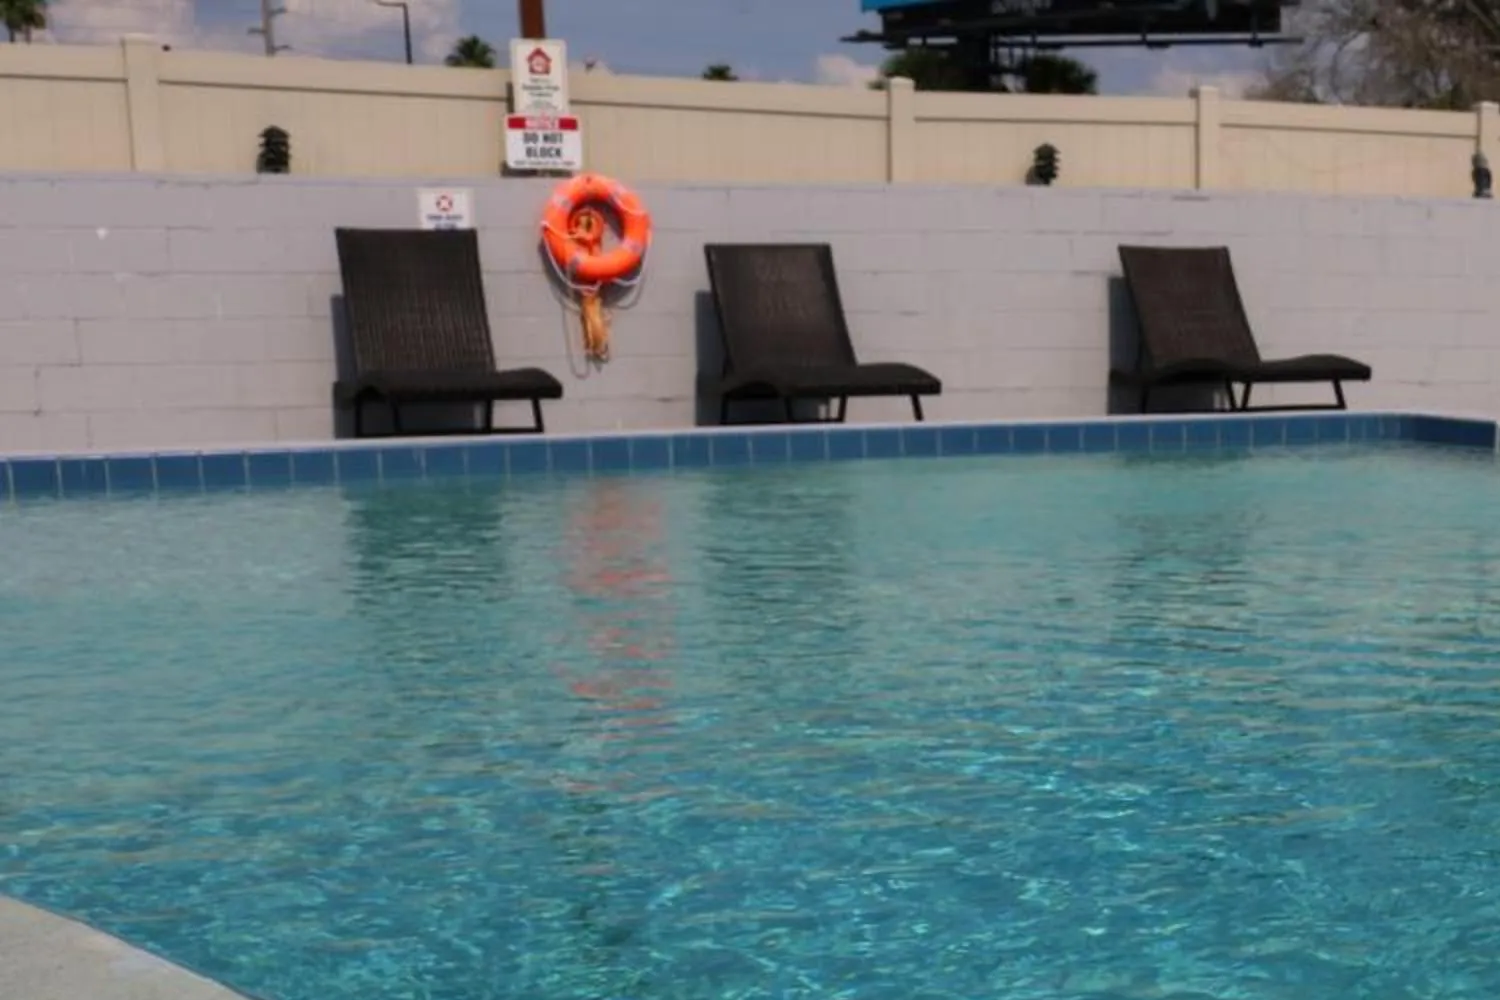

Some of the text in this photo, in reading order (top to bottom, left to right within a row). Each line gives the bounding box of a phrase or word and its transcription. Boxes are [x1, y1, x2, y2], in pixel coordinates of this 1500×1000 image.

[523, 132, 563, 144] DO NOT
[525, 146, 562, 158] BLOCK
